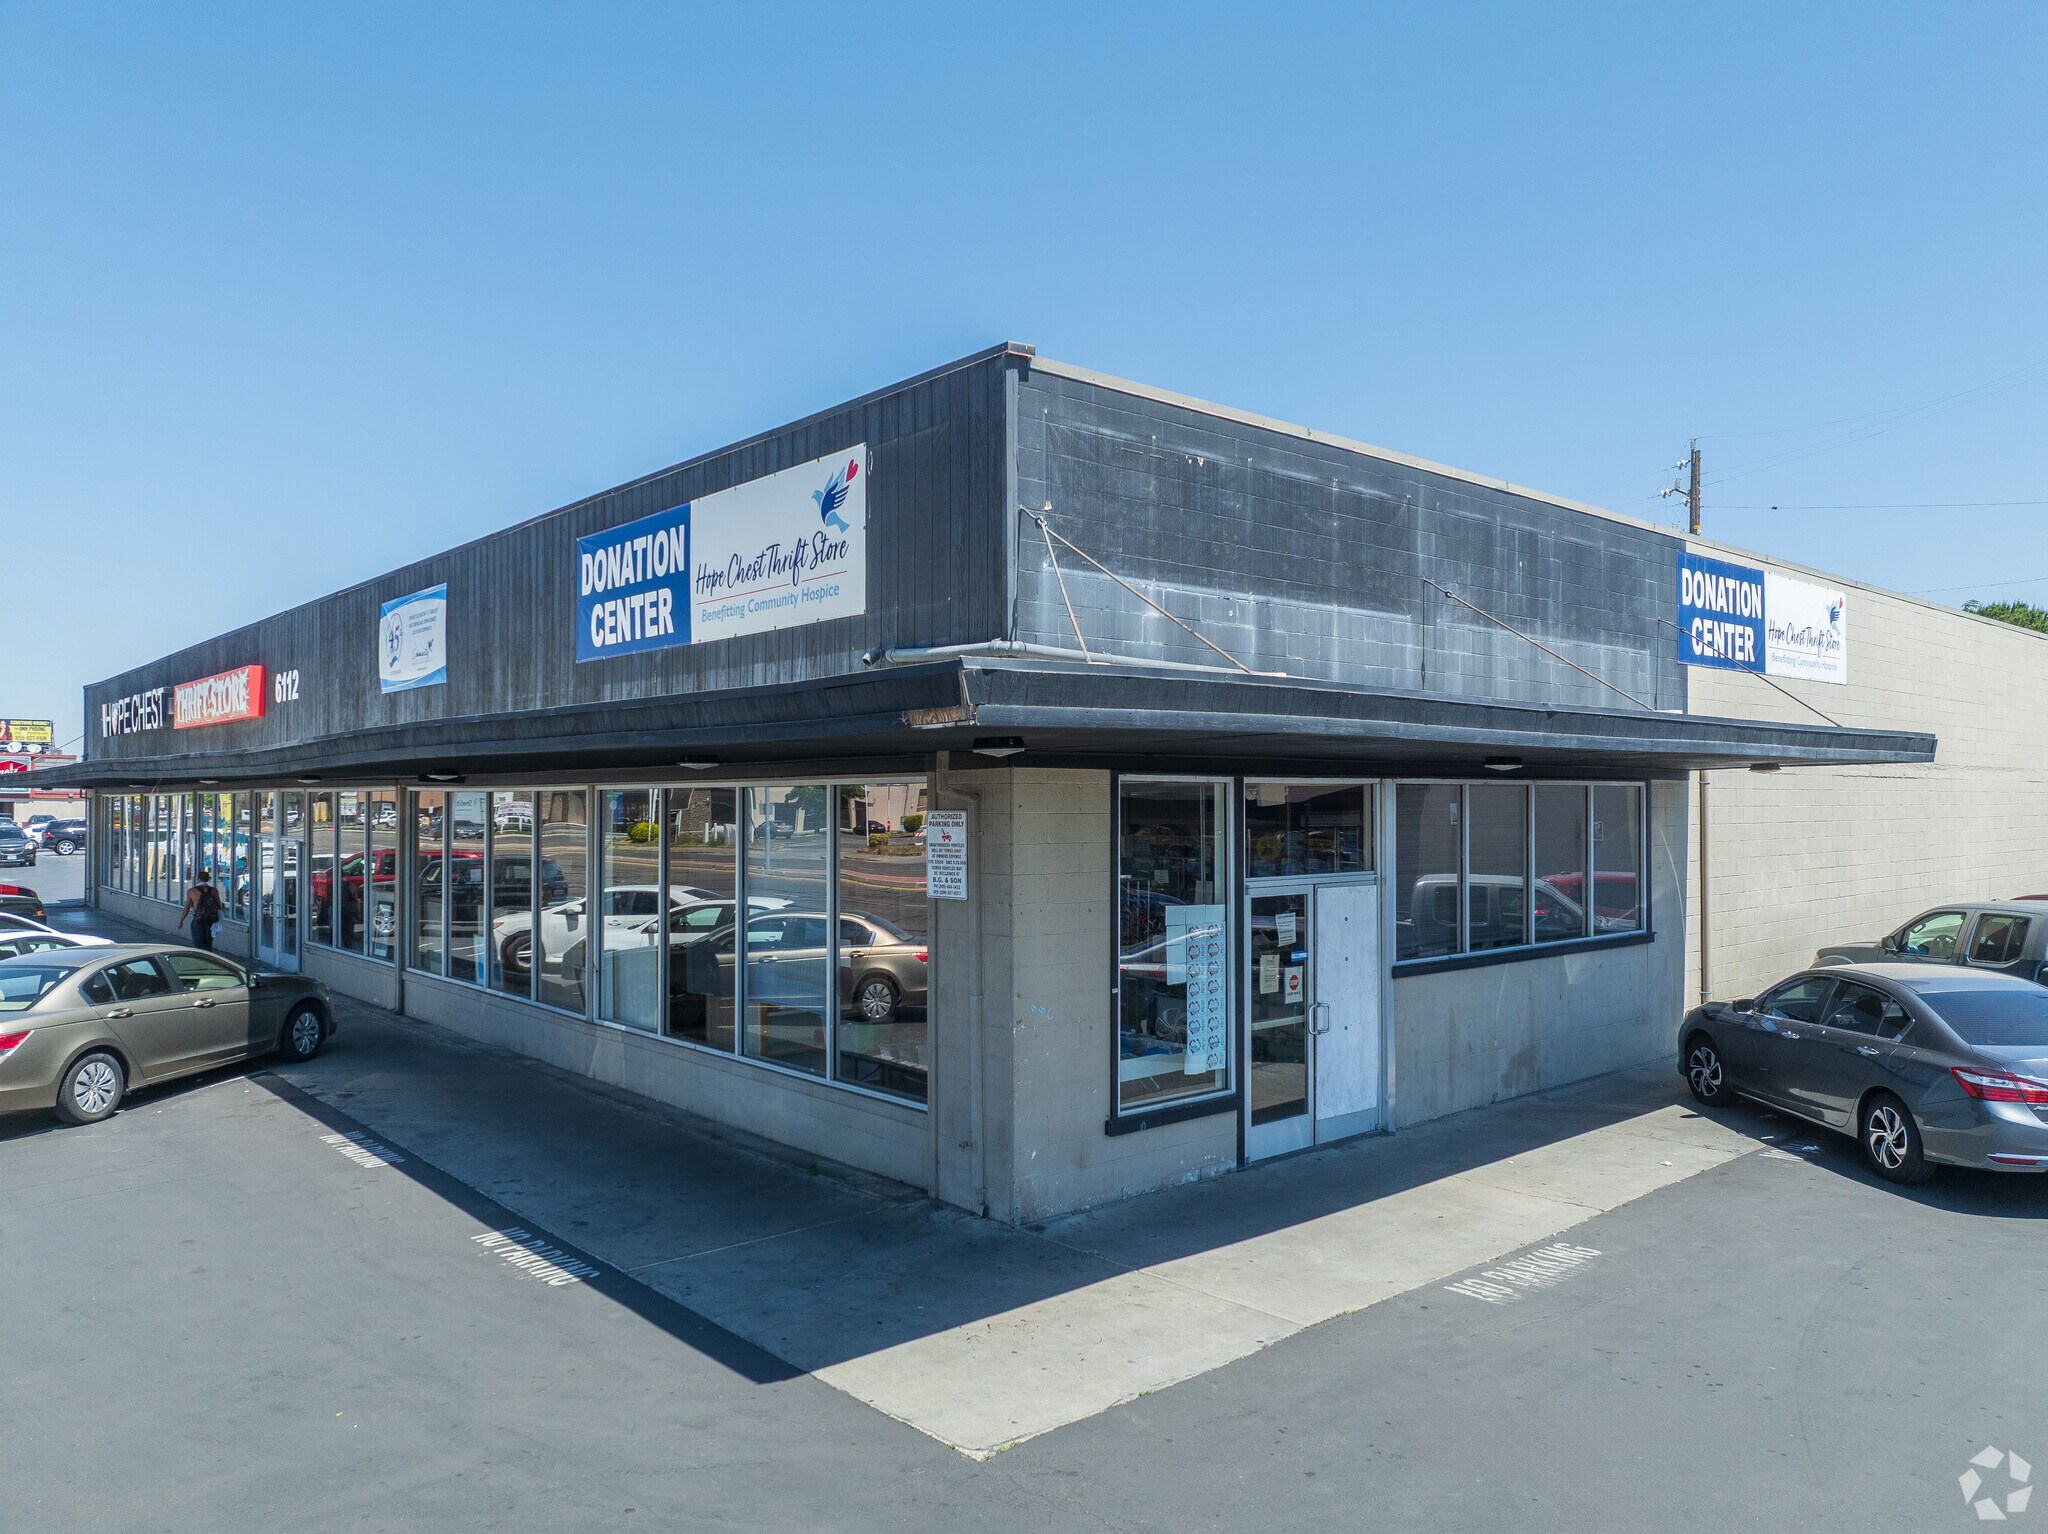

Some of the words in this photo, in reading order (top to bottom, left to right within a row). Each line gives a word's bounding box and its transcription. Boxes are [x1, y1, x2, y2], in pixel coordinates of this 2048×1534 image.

[581, 524, 685, 596] DONATION
[696, 562, 726, 597] Hope
[727, 550, 767, 588] Chest
[766, 537, 809, 587] Thrift
[810, 530, 849, 570] Store
[701, 604, 745, 623] Benefitting
[748, 592, 799, 613] Community
[801, 583, 840, 603] Hospice
[1681, 567, 1762, 619] DONATION
[591, 588, 675, 648] CENTER
[1691, 617, 1756, 663] CENTER
[1768, 619, 1785, 646] Hope
[1786, 622, 1806, 646] Chest
[1805, 626, 1825, 658] Thrift
[1825, 629, 1840, 652] Store
[131, 687, 164, 733] CHEST
[175, 682, 207, 723] THRIFT
[206, 668, 249, 717] STORE
[275, 669, 299, 703] 6112
[929, 820, 950, 828] PARKING
[952, 820, 965, 828] ONLY
[1289, 978, 1299, 987] STOP
[470, 1226, 532, 1247] NO
[493, 1240, 600, 1286] PARKING
[1481, 1242, 1602, 1293] PARKING
[1443, 1278, 1525, 1305] NO
